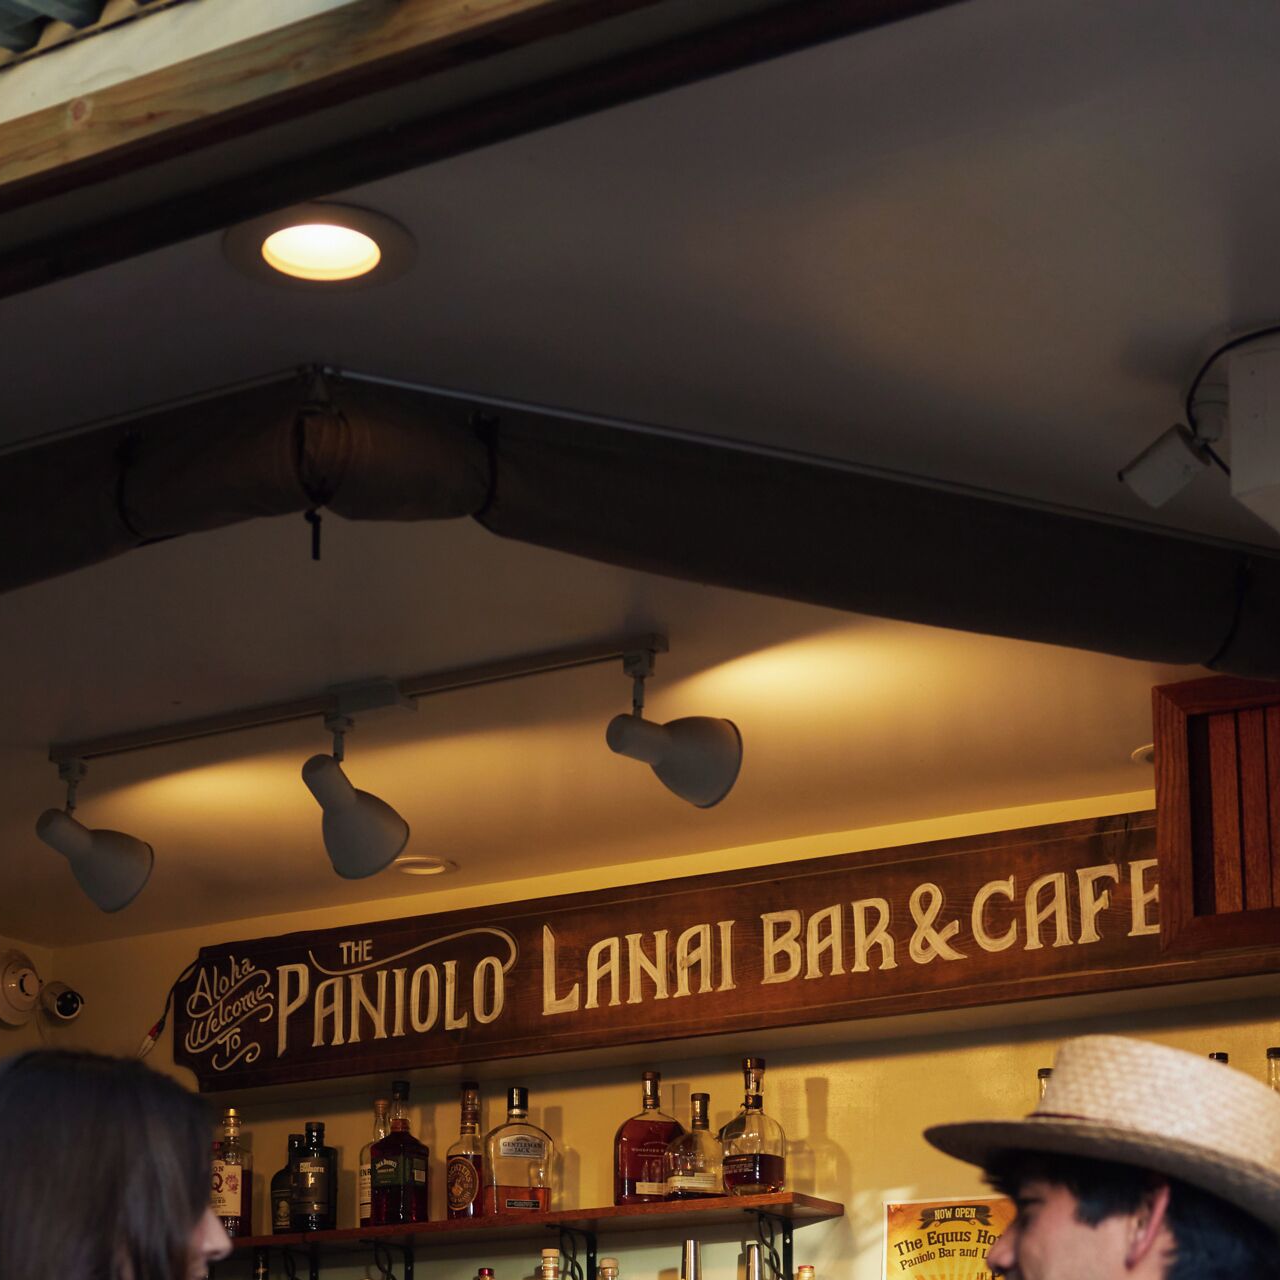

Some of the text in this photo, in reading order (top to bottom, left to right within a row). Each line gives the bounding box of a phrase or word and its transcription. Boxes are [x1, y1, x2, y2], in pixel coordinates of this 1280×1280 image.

[339, 938, 374, 965] THE
[187, 955, 256, 1017] Aloha
[276, 954, 508, 1059] PANIOLO
[542, 919, 737, 1017] LANAI
[185, 984, 274, 1048] Welcome
[217, 1027, 241, 1058] To
[503, 1141, 542, 1149] GENTLEMAN
[934, 1207, 977, 1220] NOW OPEN
[894, 1238, 923, 1256] The
[927, 1231, 971, 1246] Equus
[900, 1250, 935, 1270] Paniolo
[939, 1248, 956, 1258] Bar
[960, 1247, 978, 1257] and
